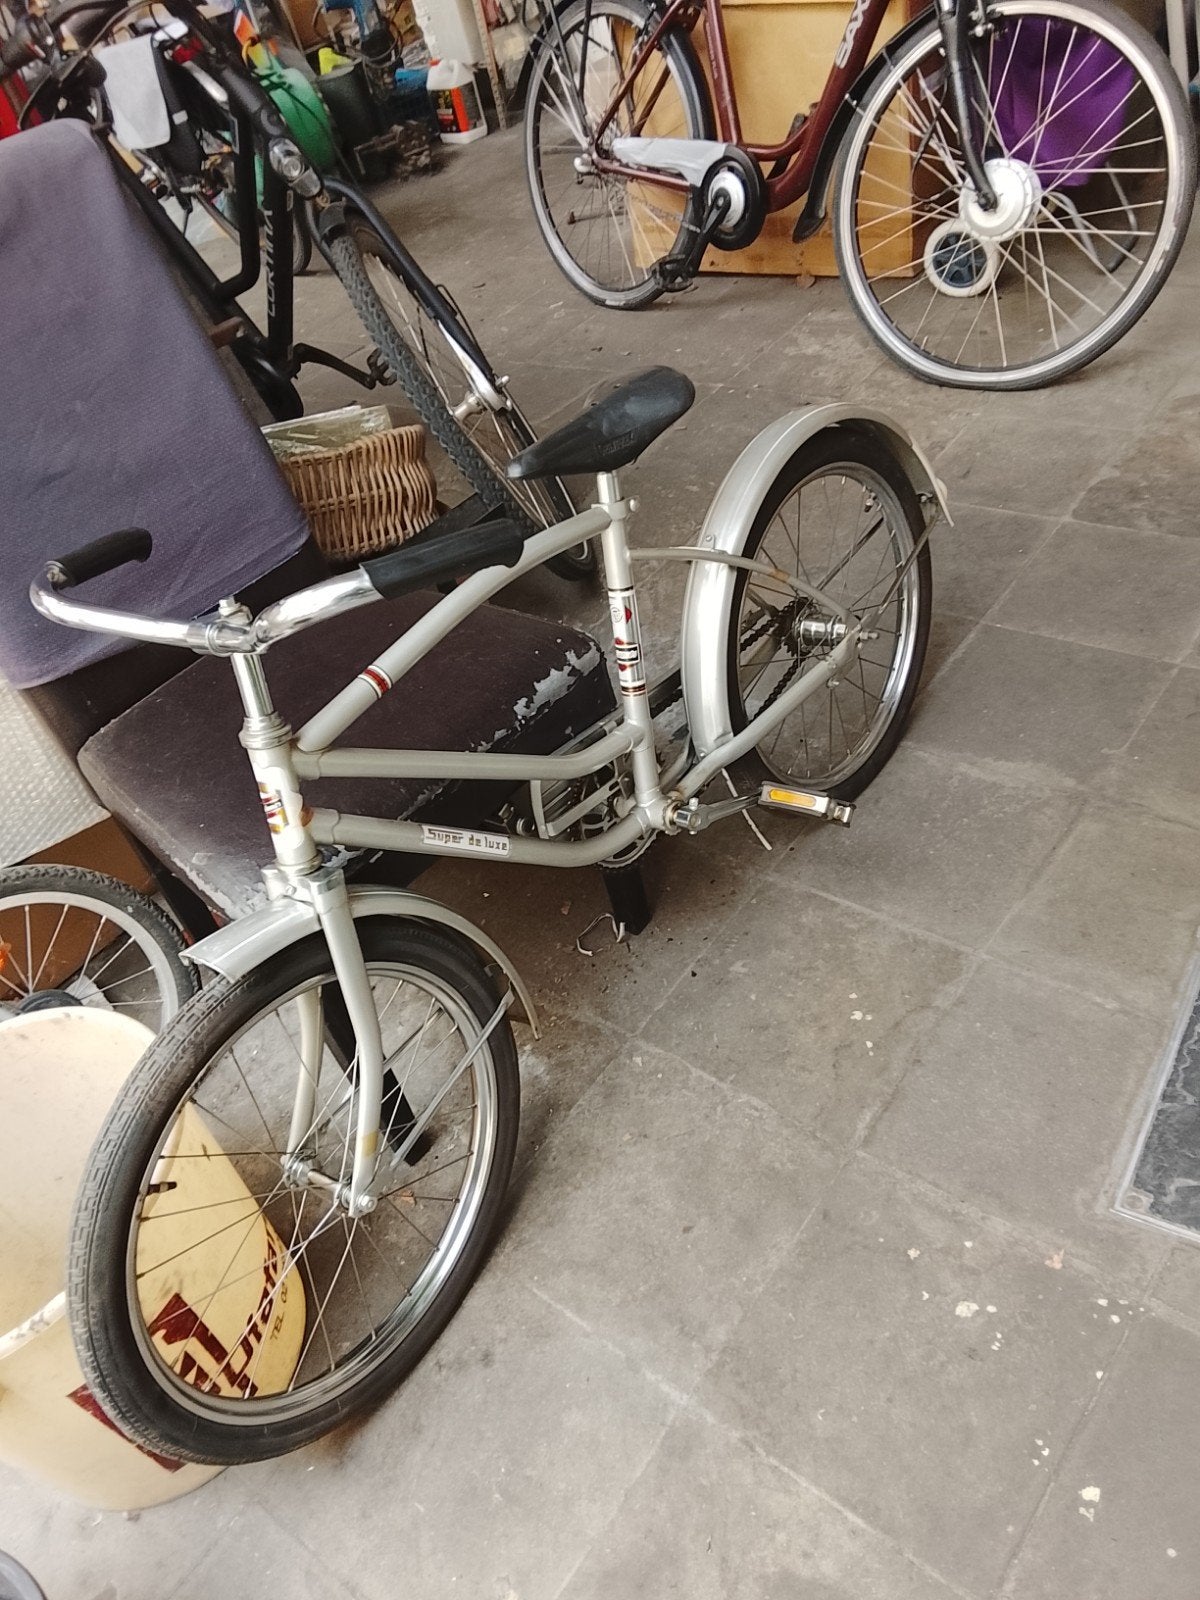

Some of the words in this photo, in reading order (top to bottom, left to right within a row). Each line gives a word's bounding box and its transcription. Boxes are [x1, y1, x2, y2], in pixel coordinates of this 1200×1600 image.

[426, 827, 463, 844] Super
[468, 834, 481, 847] de
[484, 836, 507, 850] luxe
